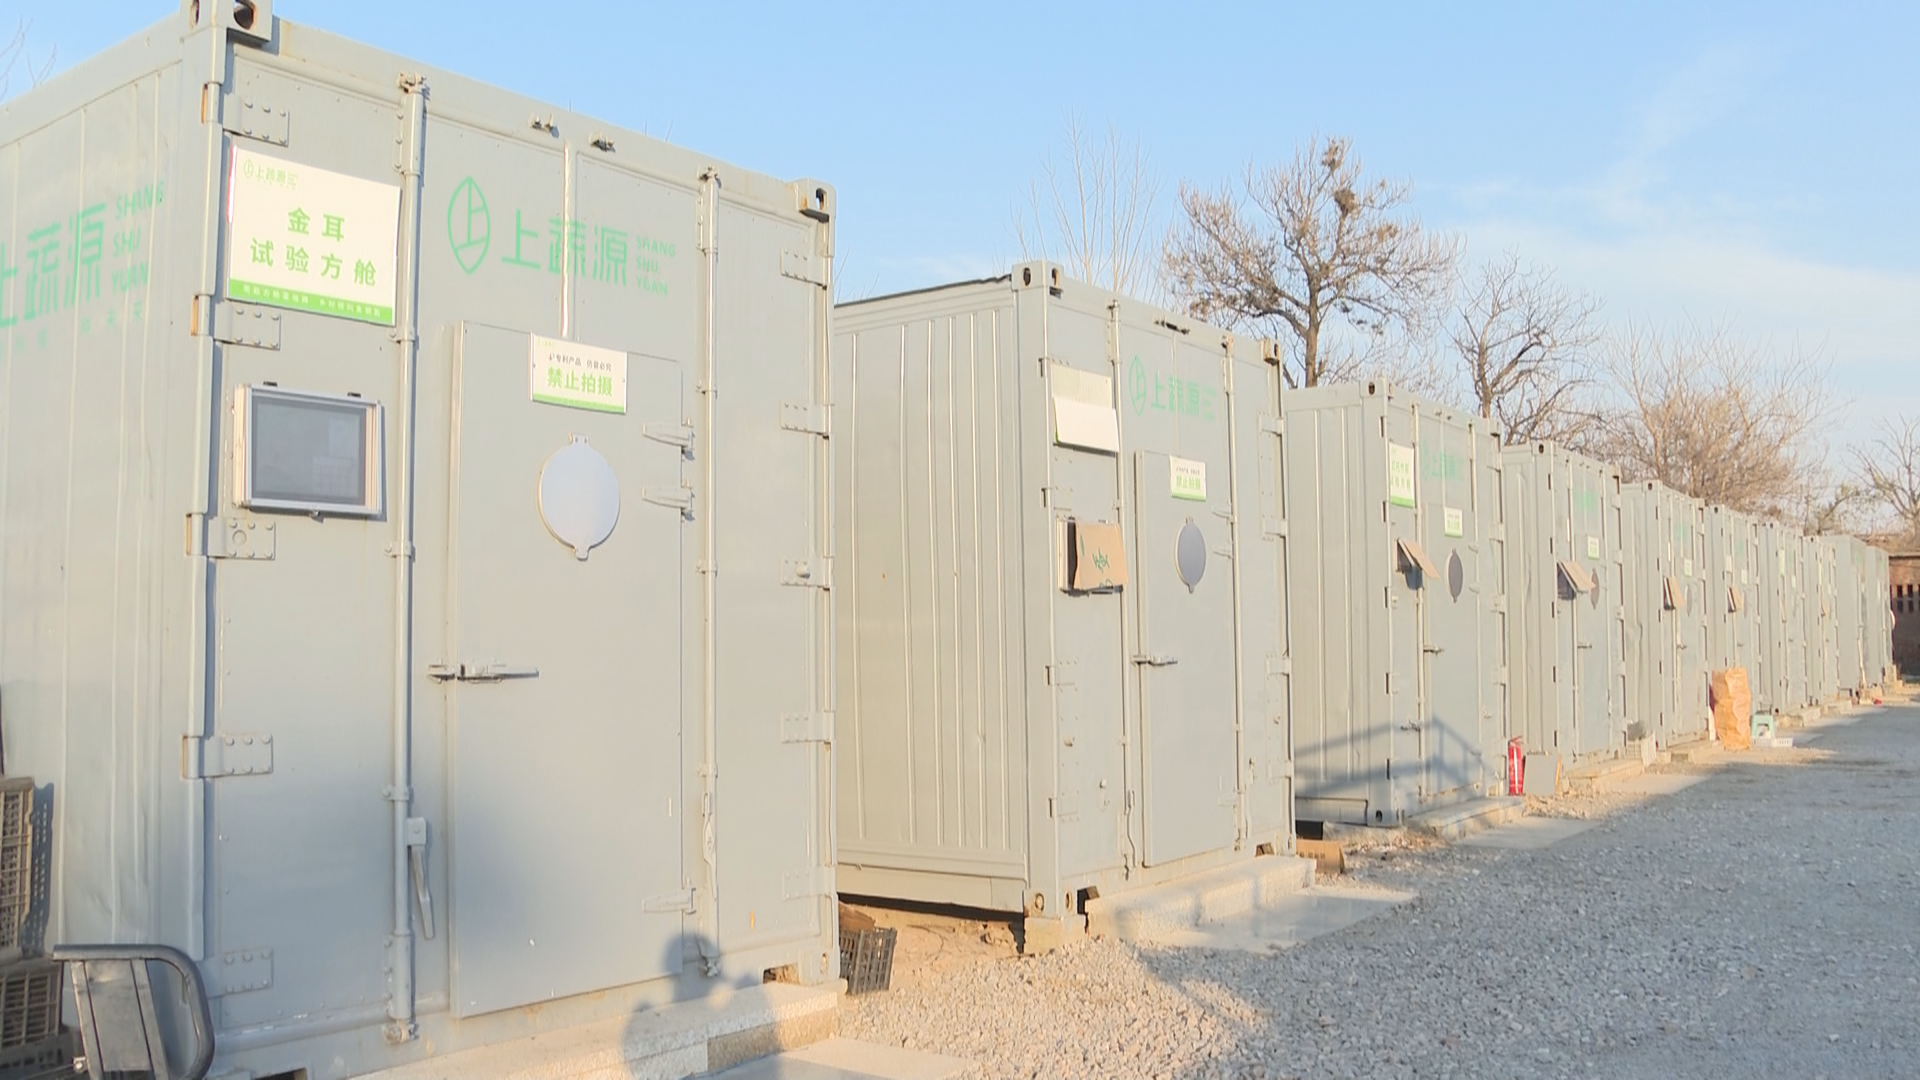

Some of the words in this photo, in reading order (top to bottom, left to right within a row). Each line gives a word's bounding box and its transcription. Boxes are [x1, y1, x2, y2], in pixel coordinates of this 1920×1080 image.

[287, 207, 345, 242] 金耳
[113, 226, 142, 258] SHU
[501, 209, 628, 287] 上蔬源
[636, 236, 677, 258] SHANG
[111, 261, 149, 294] YUAN
[250, 238, 377, 287] 试验方舱
[636, 255, 660, 273] SHU
[636, 276, 669, 297] YUAN
[547, 366, 613, 397] 禁止拍摄
